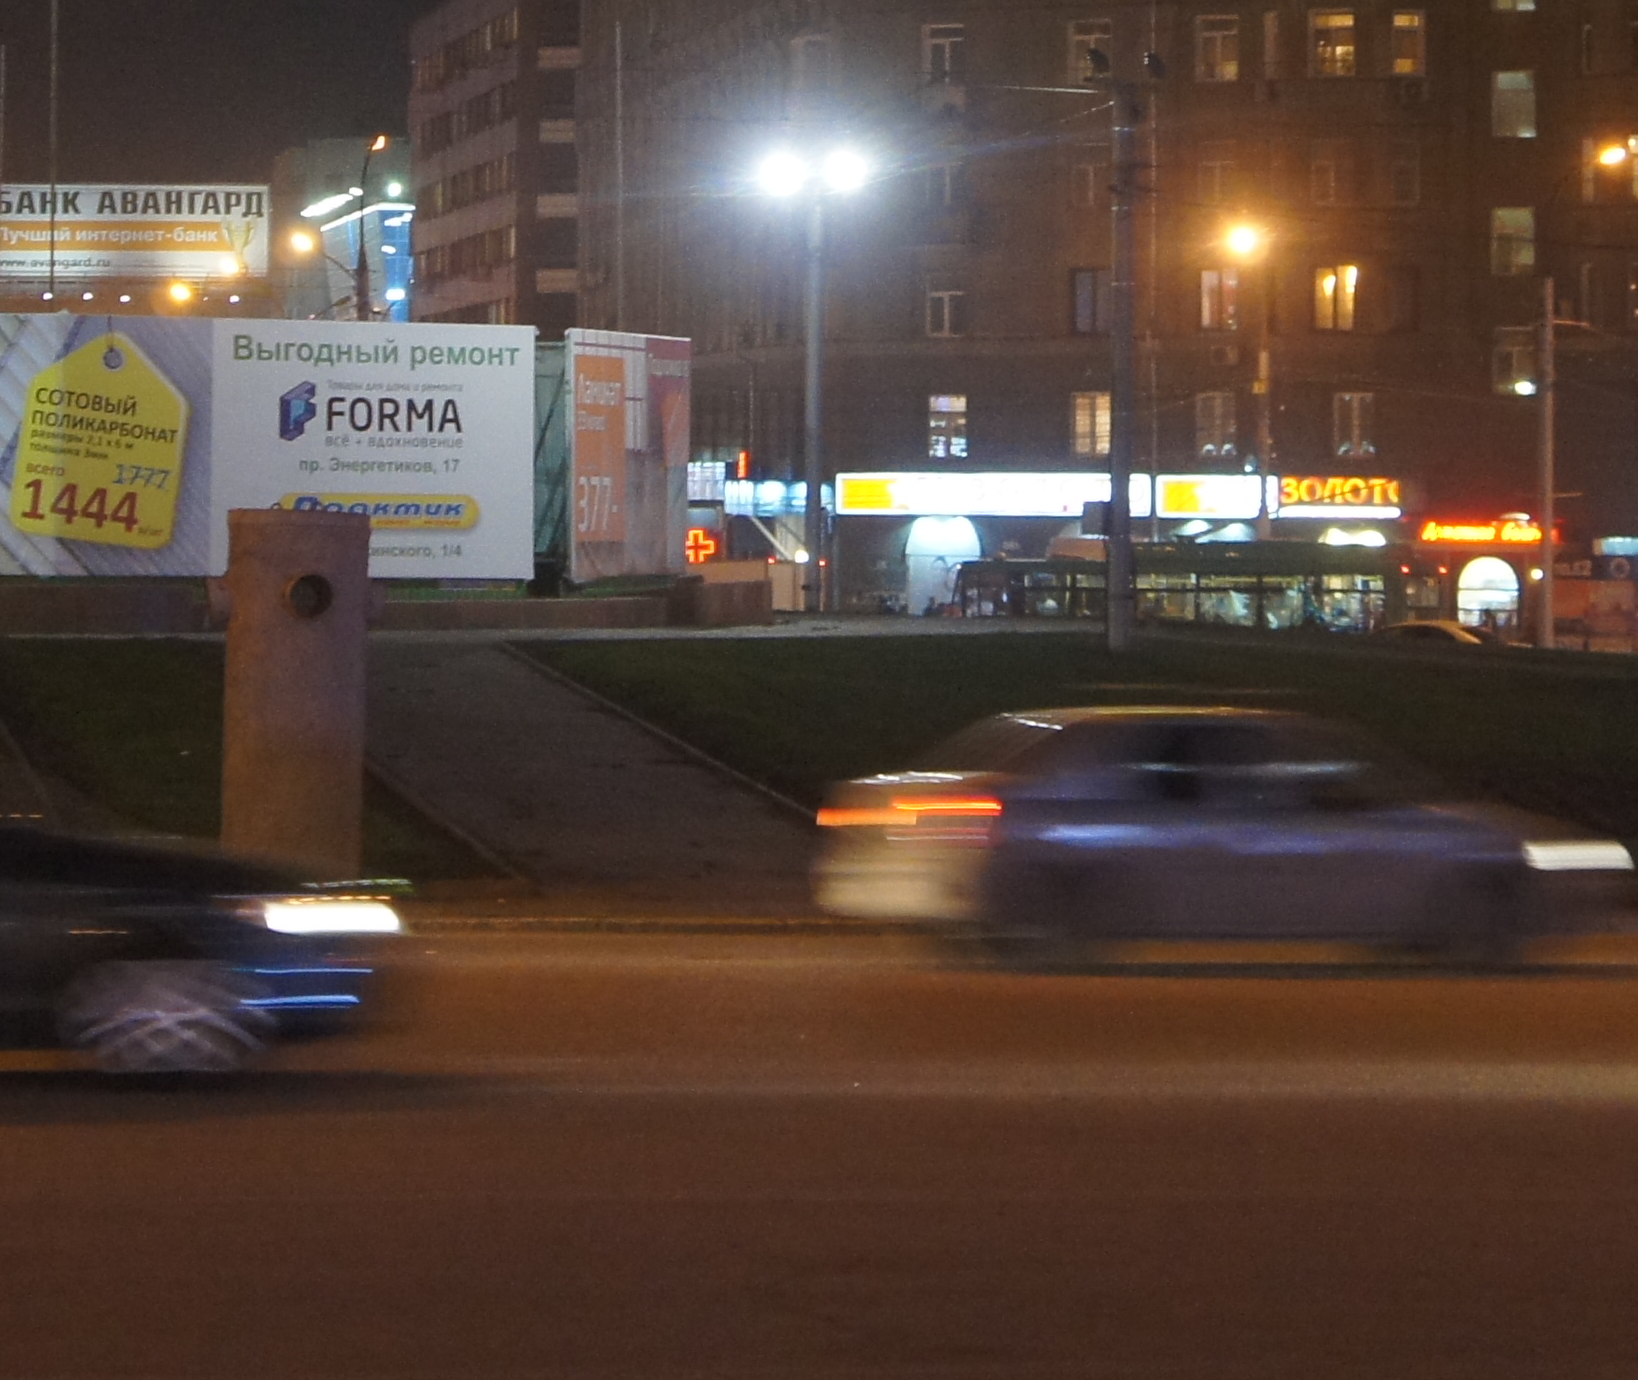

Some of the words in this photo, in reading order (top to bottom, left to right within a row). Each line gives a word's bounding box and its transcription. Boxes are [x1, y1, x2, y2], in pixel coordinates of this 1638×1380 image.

[97, 191, 264, 218] АВАНГАРД
[76, 226, 219, 244] интернет-банк
[233, 334, 399, 367] Выгодный
[410, 343, 520, 370] ремонт
[35, 387, 138, 417] СОТОВЫЙ
[326, 395, 463, 434] FORMA
[31, 410, 178, 444] ПОЛИКАРБОНАТ
[443, 458, 461, 473] 17
[20, 478, 140, 533] 1444
